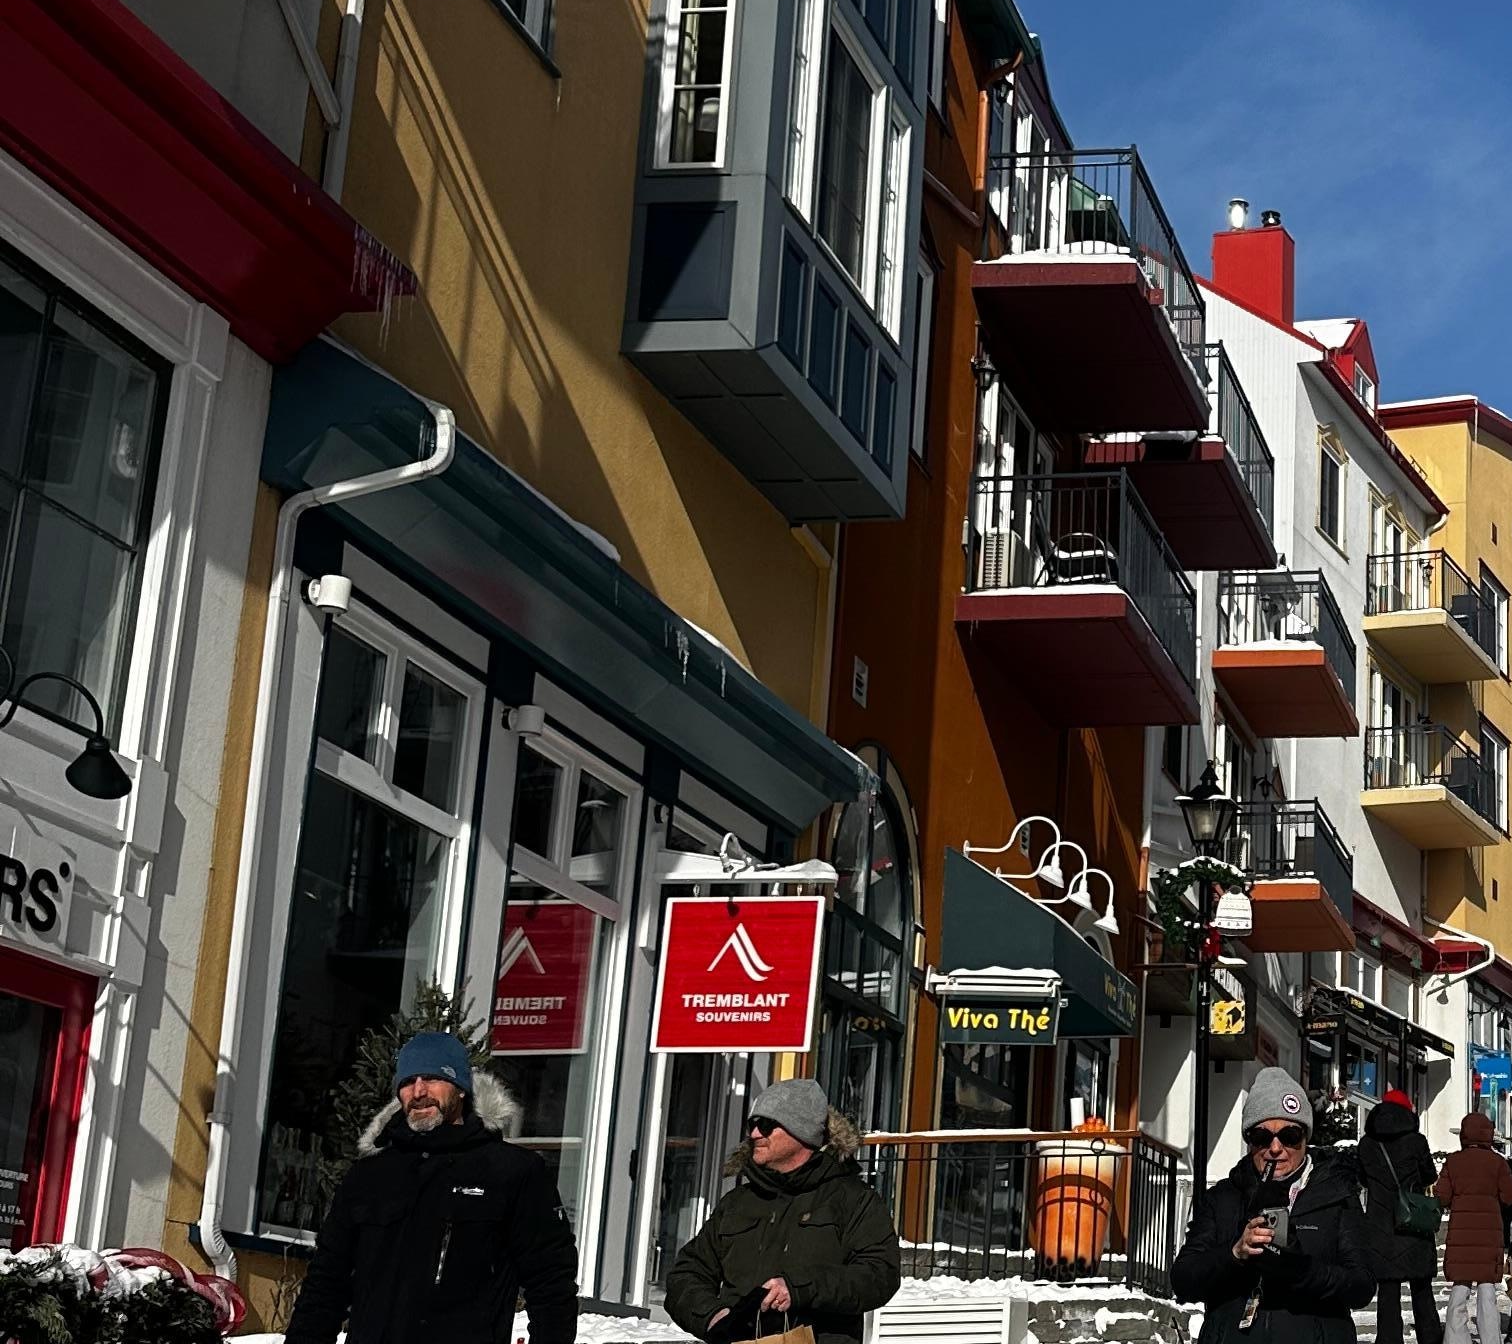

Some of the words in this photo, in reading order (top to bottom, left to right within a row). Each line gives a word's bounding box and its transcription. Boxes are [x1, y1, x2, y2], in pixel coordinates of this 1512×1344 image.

[682, 993, 790, 1008] TREMBLANT
[696, 1011, 771, 1023] SOUVENIRS
[947, 1007, 999, 1030] Viva
[1008, 1007, 1051, 1036] Thé
